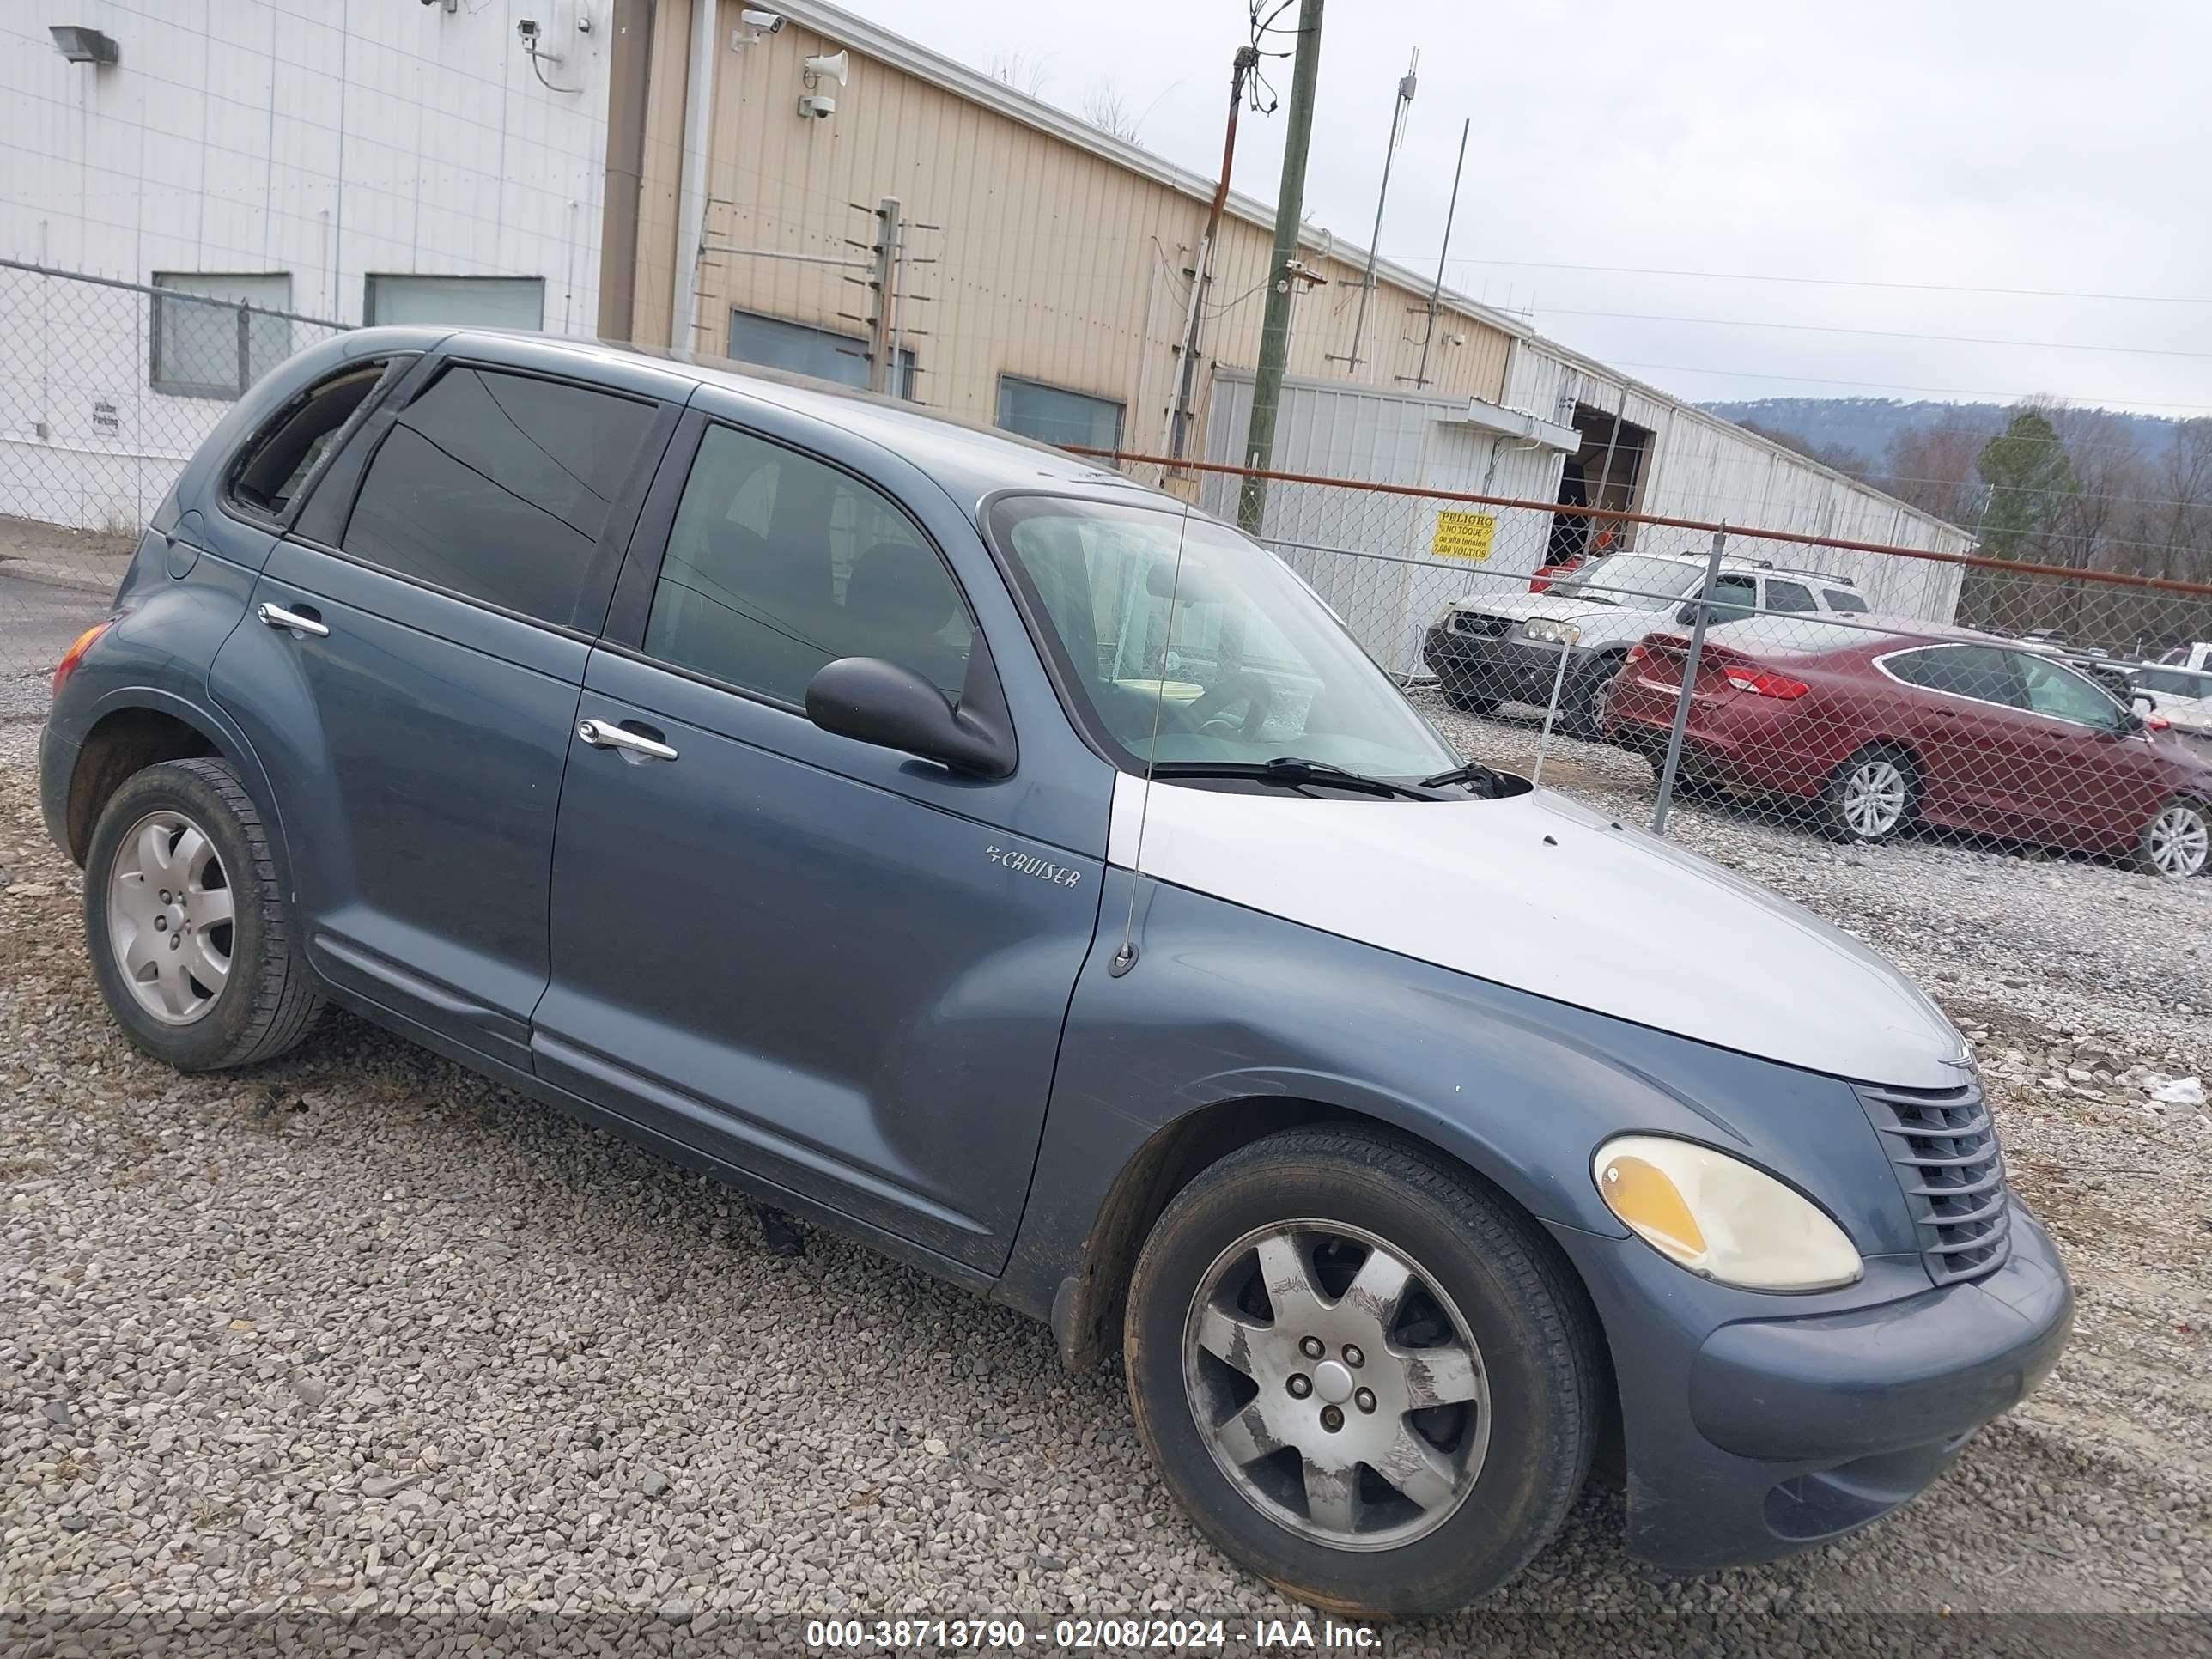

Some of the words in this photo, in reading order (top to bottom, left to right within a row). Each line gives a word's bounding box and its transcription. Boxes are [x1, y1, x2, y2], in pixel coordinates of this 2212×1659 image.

[93, 414, 118, 429] Parking
[1442, 512, 1493, 526] PELIGRO
[1446, 525, 1457, 533] NO
[1457, 526, 1483, 537] TOQUE
[1439, 534, 1448, 543] de
[1449, 536, 1461, 544] alta
[1453, 545, 1486, 558] VOLTIOS
[1002, 851, 1081, 888] CRUISER
